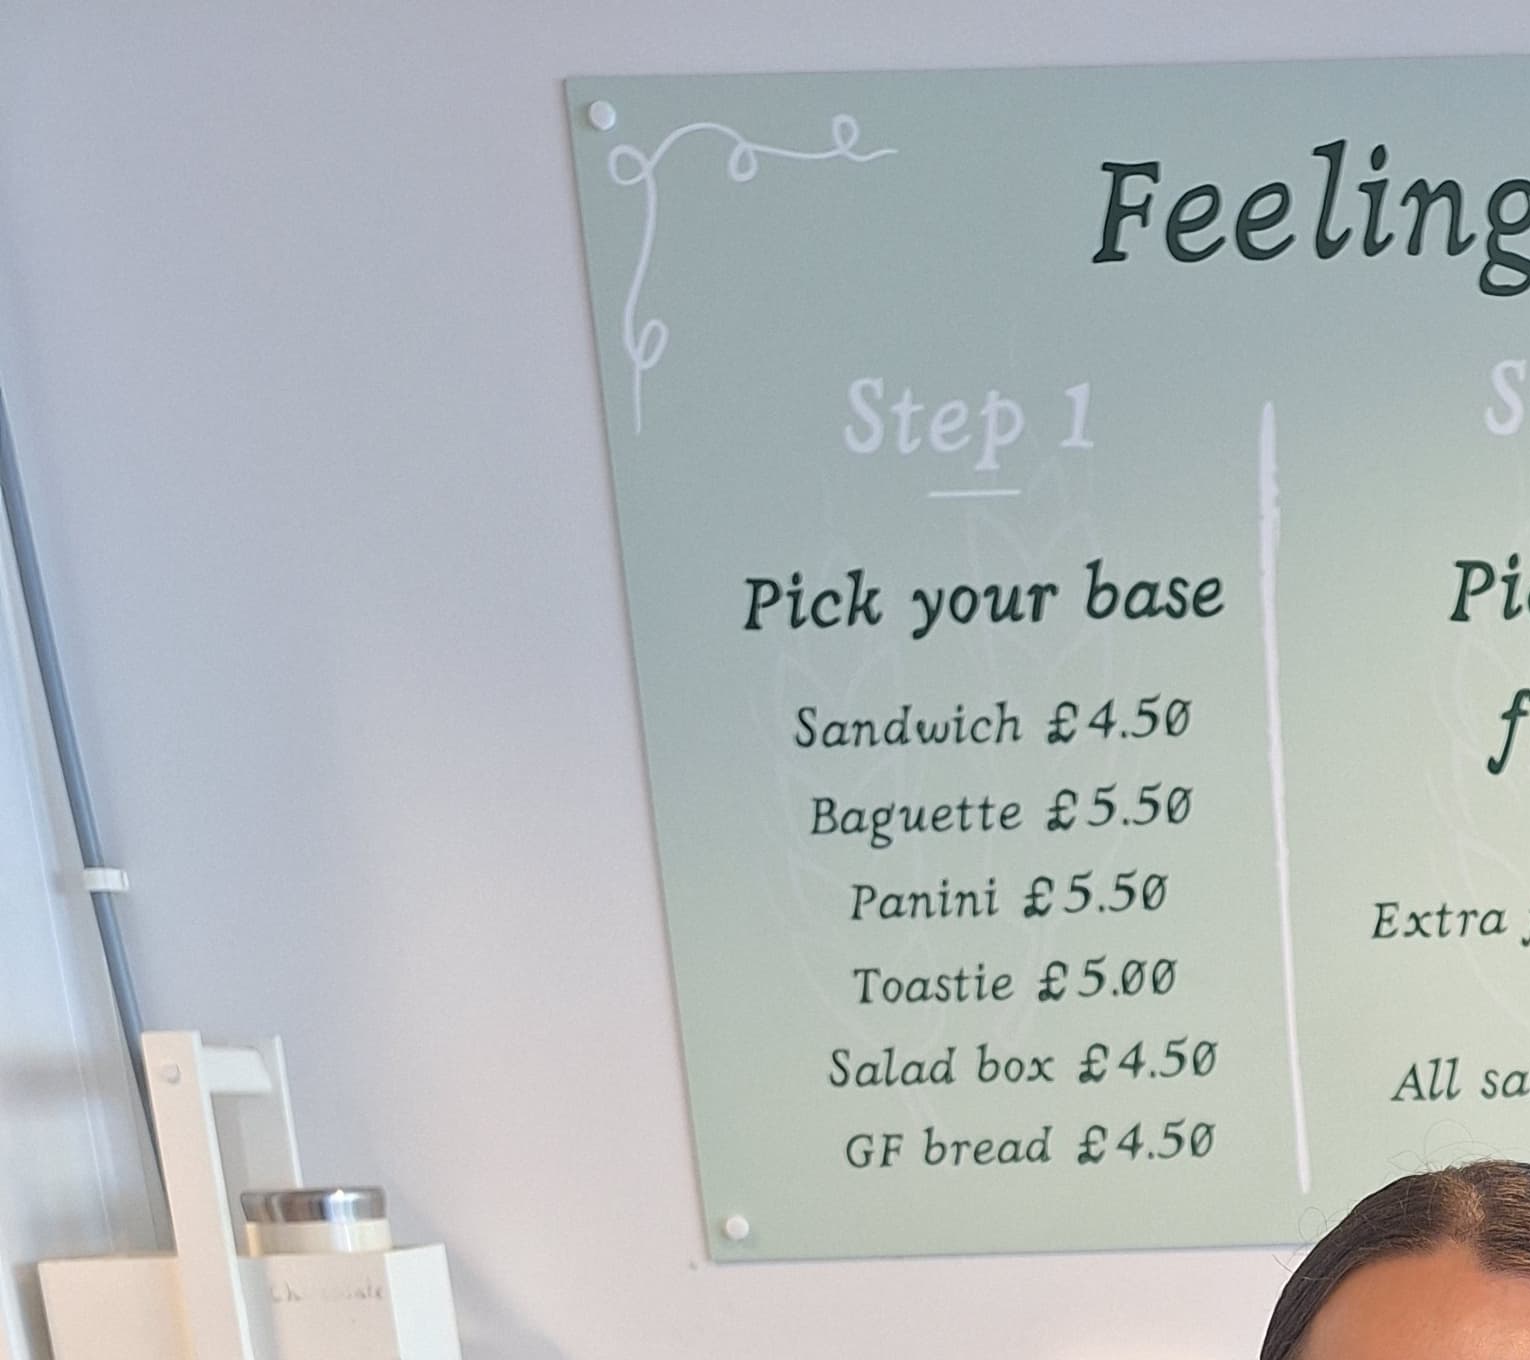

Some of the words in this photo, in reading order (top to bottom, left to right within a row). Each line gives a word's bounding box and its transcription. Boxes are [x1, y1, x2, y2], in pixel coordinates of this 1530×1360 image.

[844, 377, 1025, 472] Step
[1059, 382, 1095, 450] 1
[743, 568, 883, 631] Pick
[911, 583, 1059, 641] your
[1085, 558, 1225, 620] base
[794, 700, 1021, 749] Sandwich
[1047, 694, 1191, 745] £4.50
[810, 796, 1022, 850] Baguette
[1046, 782, 1193, 832] £5.50
[851, 877, 998, 921] Panini
[1023, 870, 1168, 919] £5.50
[1371, 901, 1507, 939] Extra
[853, 963, 1013, 1004] Toastie
[1037, 955, 1177, 1003] £5.00
[829, 1046, 956, 1088] Salad
[977, 1043, 1054, 1083] box
[1078, 1037, 1218, 1084] £4.50
[1390, 1056, 1461, 1102] All
[845, 1133, 904, 1169] GF
[923, 1125, 1053, 1166] bread
[1076, 1119, 1215, 1165] £4.50
